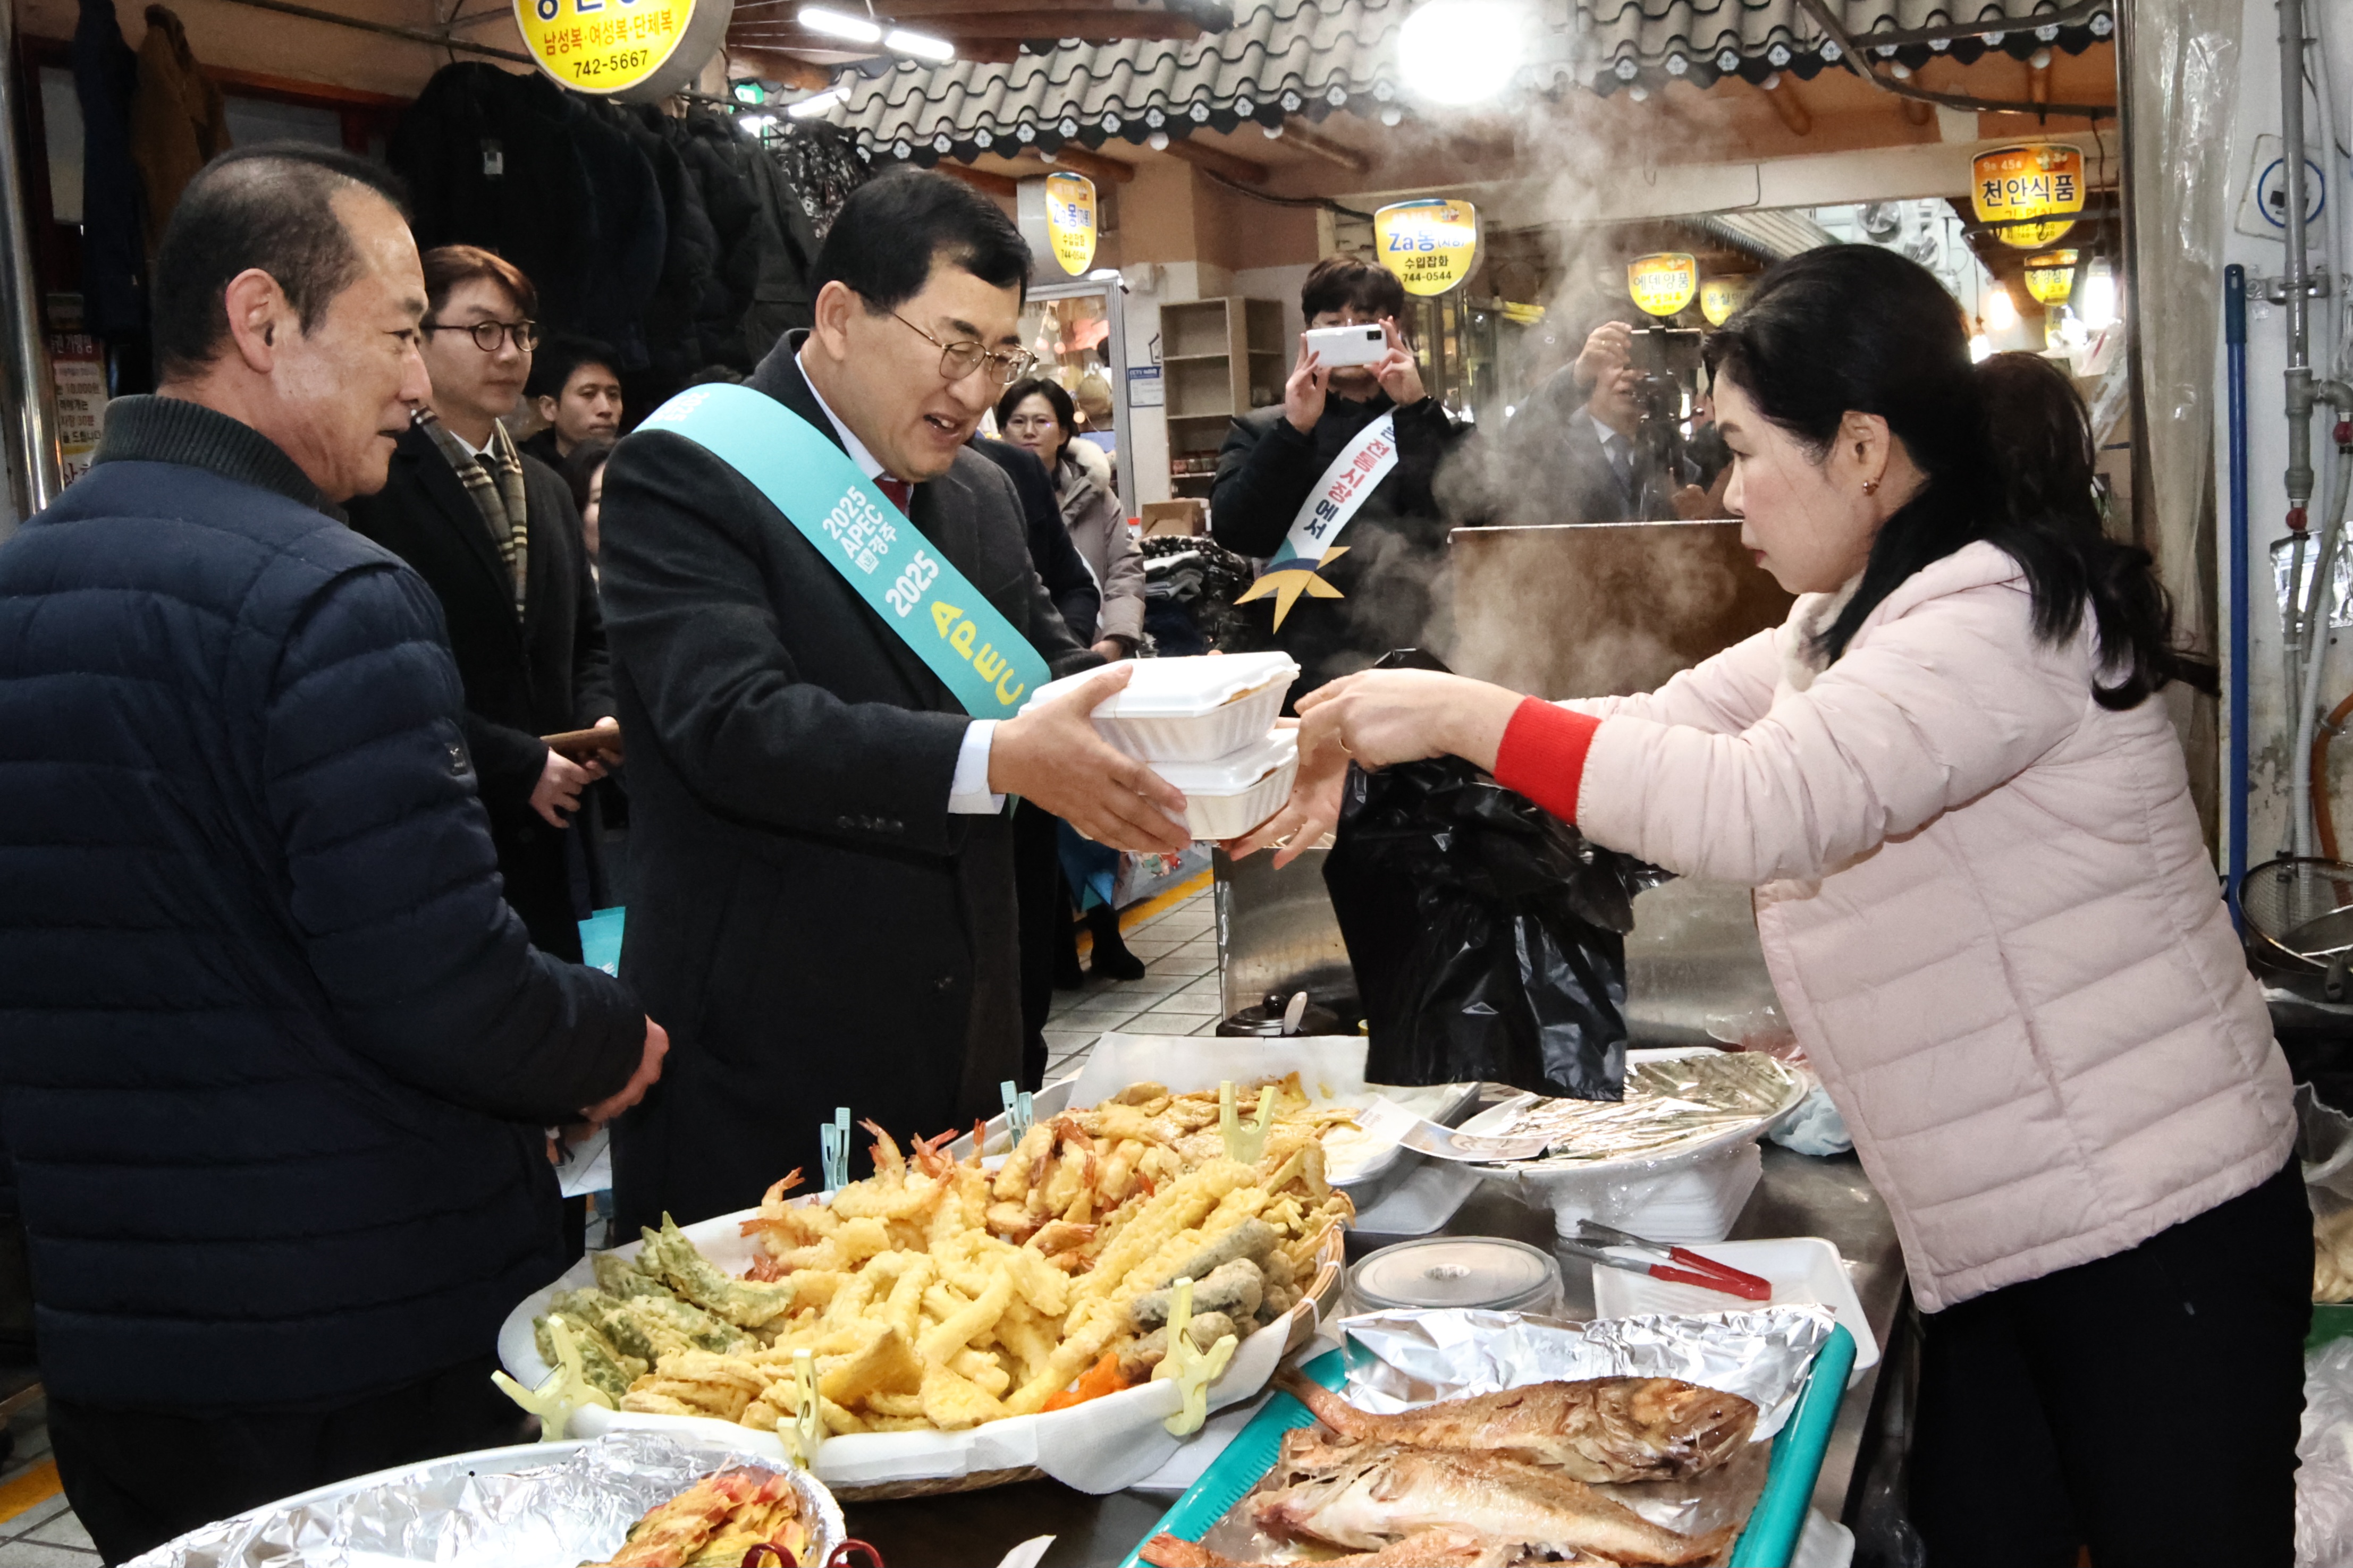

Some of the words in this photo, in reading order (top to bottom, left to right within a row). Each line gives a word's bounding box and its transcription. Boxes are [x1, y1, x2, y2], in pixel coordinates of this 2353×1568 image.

[574, 50, 648, 78] 742-5667
[1981, 174, 2075, 207] 천안식품
[1063, 233, 1084, 247] 수입잡화
[1389, 230, 1435, 252] Za몽
[1061, 249, 1086, 260] 744-0544
[1405, 255, 1449, 269] 수입잡화
[1403, 271, 1452, 283] 744-0544
[1633, 272, 1689, 291] 에덴양품
[822, 485, 866, 540] 2025
[840, 504, 883, 560] APEC
[867, 521, 897, 555] 경주
[885, 549, 939, 618] 2025
[931, 600, 1025, 706] APEC
